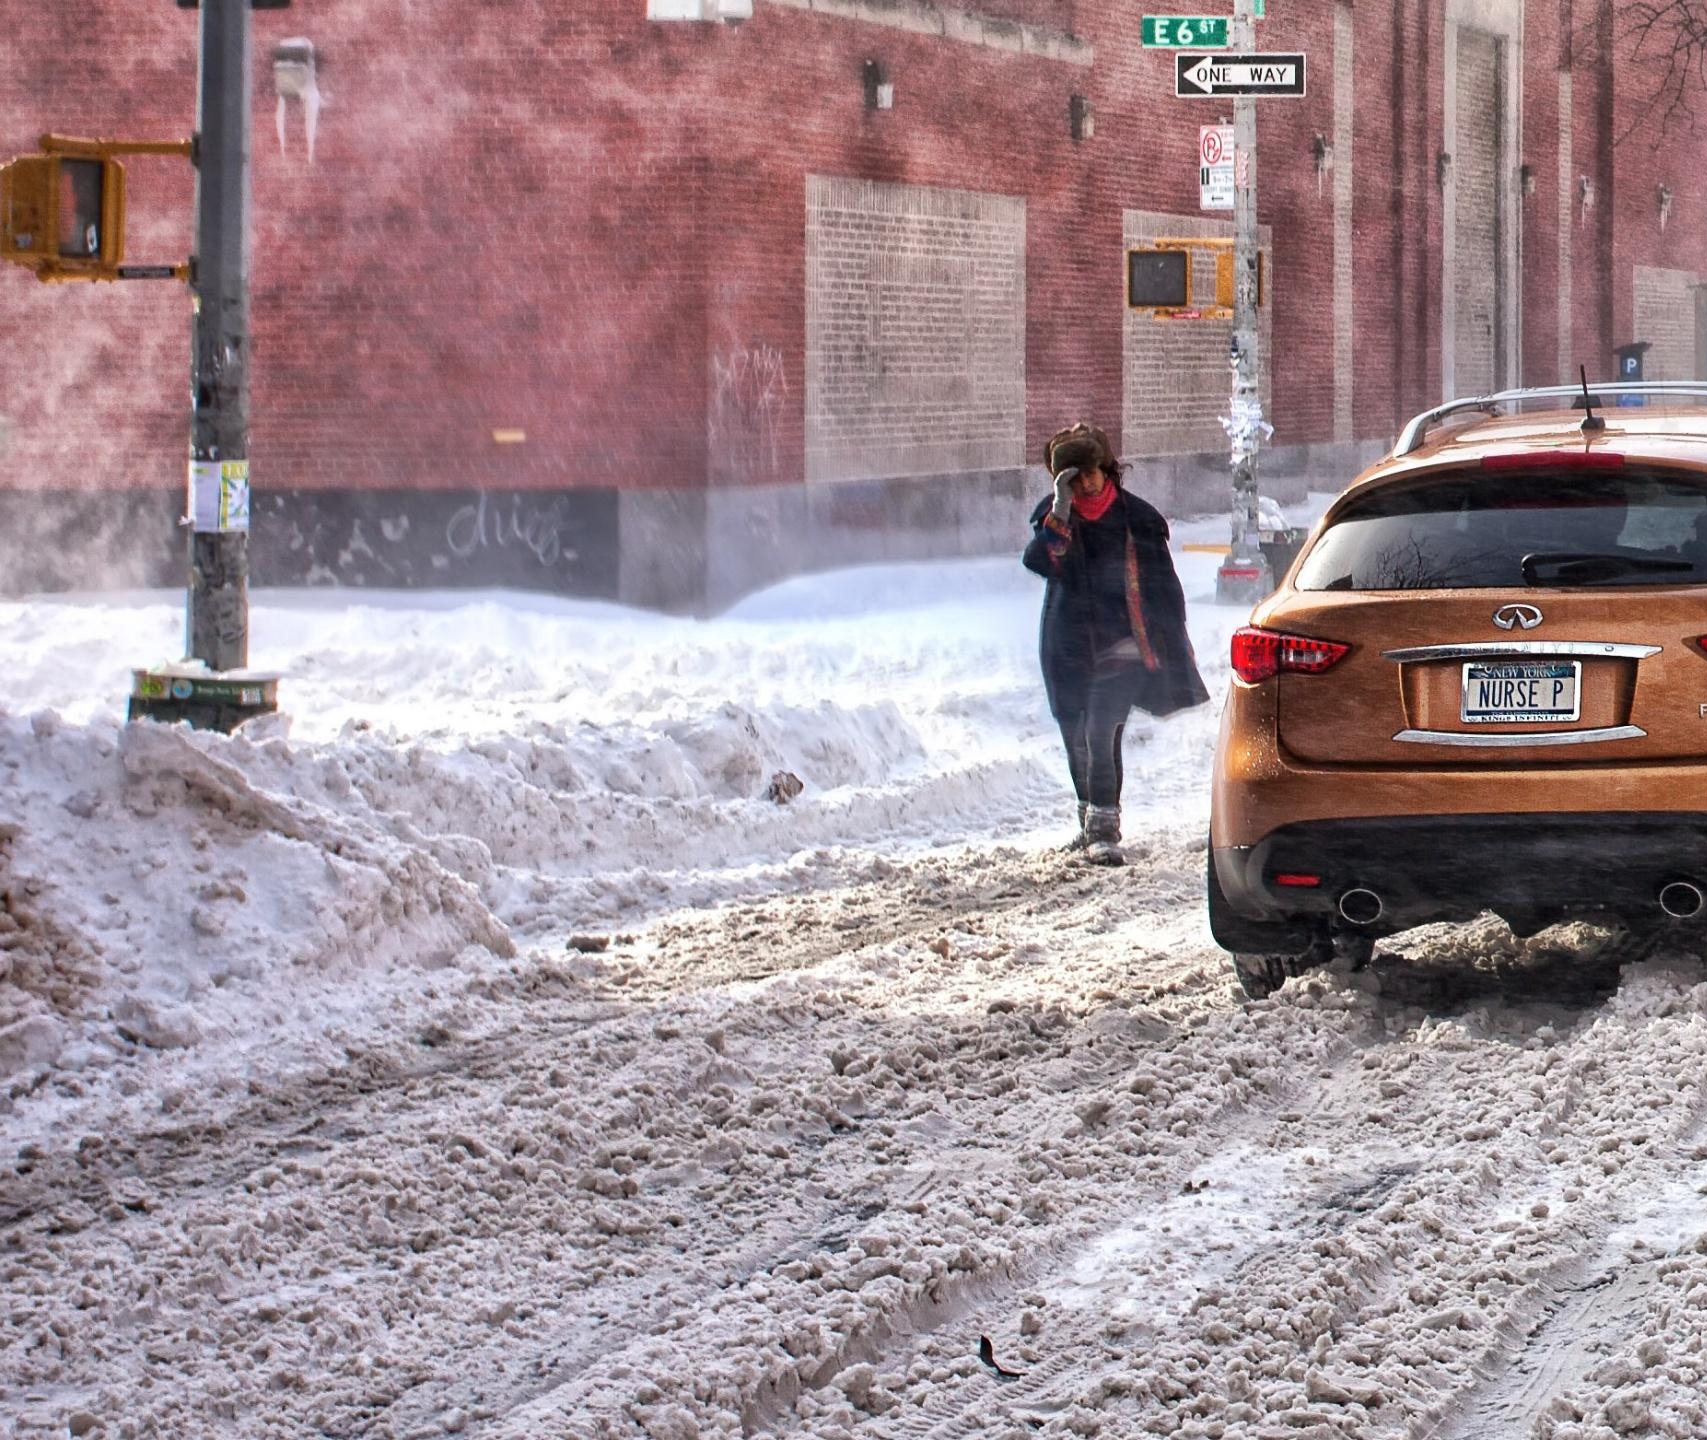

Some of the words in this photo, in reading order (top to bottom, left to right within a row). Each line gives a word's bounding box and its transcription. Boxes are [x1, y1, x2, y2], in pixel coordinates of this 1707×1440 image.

[1154, 19, 1170, 44] E
[1177, 20, 1194, 45] 6
[1199, 20, 1216, 34] ST
[1196, 67, 1232, 83] ONE
[1250, 67, 1287, 83] WAY
[1627, 357, 1637, 374] P
[1494, 667, 1520, 678] NEW
[1522, 667, 1552, 678] YORK
[1479, 680, 1540, 708] NURSE
[1552, 680, 1564, 708] P
